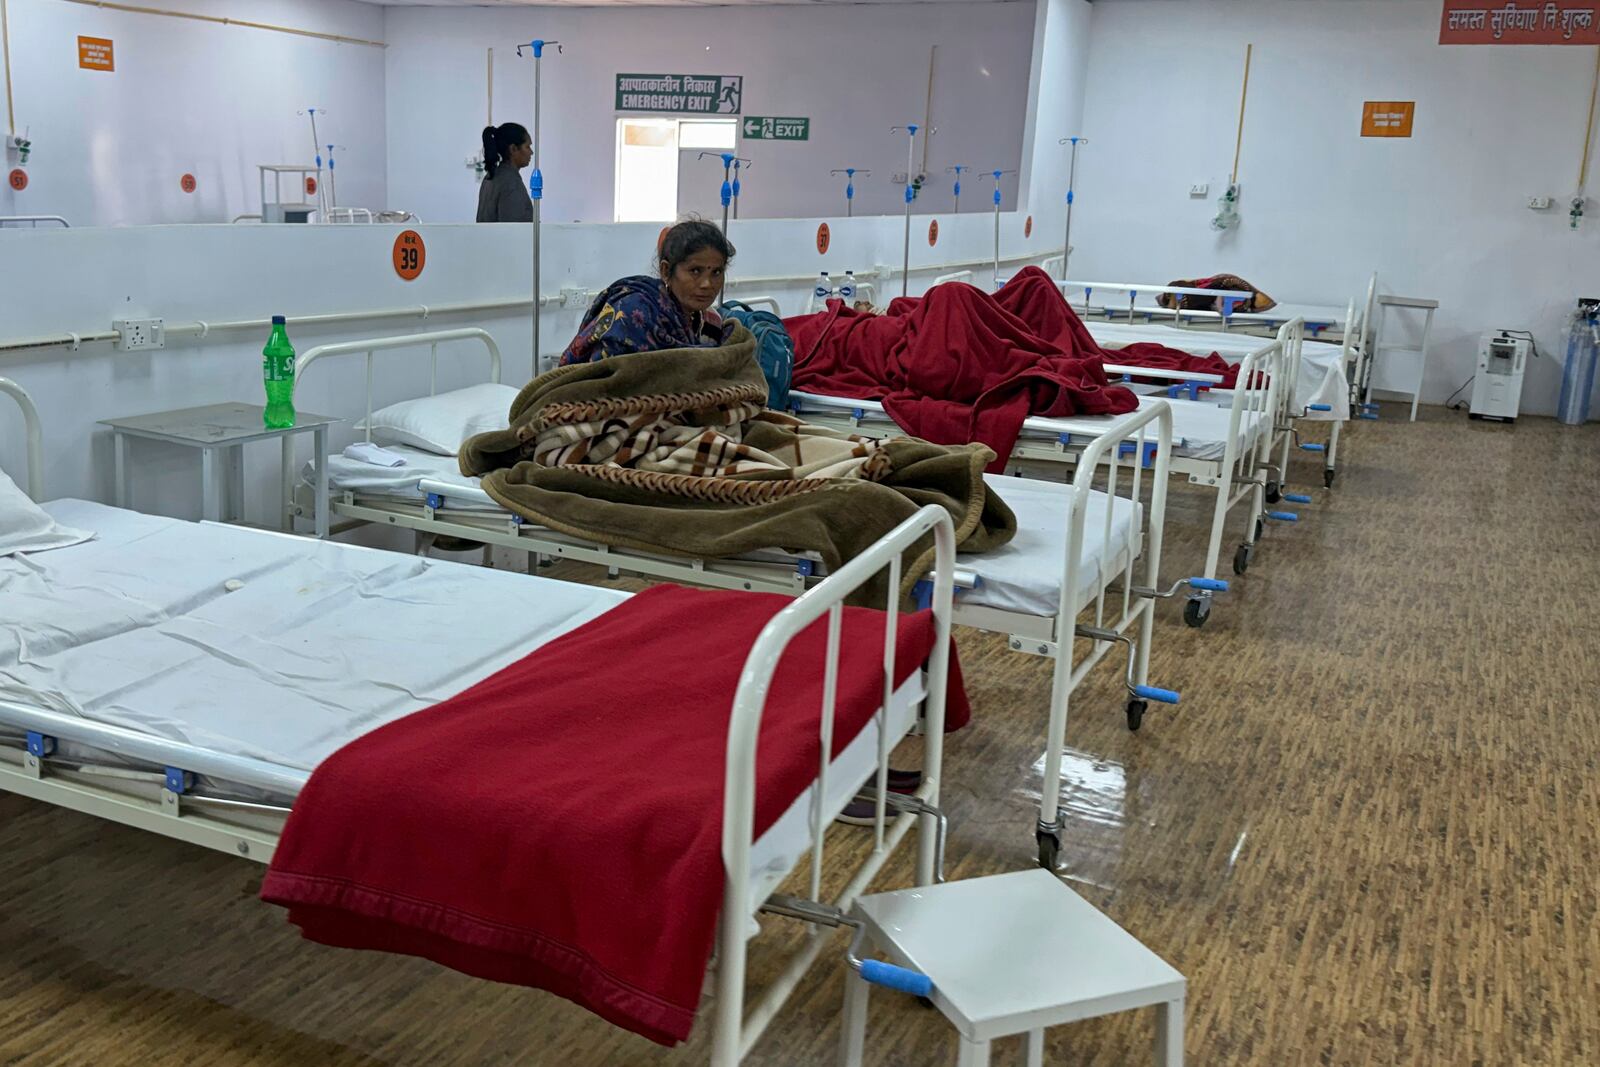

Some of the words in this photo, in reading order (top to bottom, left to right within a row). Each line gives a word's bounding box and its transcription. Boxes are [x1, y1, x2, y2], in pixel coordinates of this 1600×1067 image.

[1448, 9, 1487, 30] समस्त
[619, 75, 680, 92] आपातकालीन
[683, 76, 717, 93] निकास
[622, 94, 686, 110] EMERGENCY
[687, 96, 712, 111] EXIT
[775, 125, 805, 137] EXIT
[400, 247, 418, 270] 39
